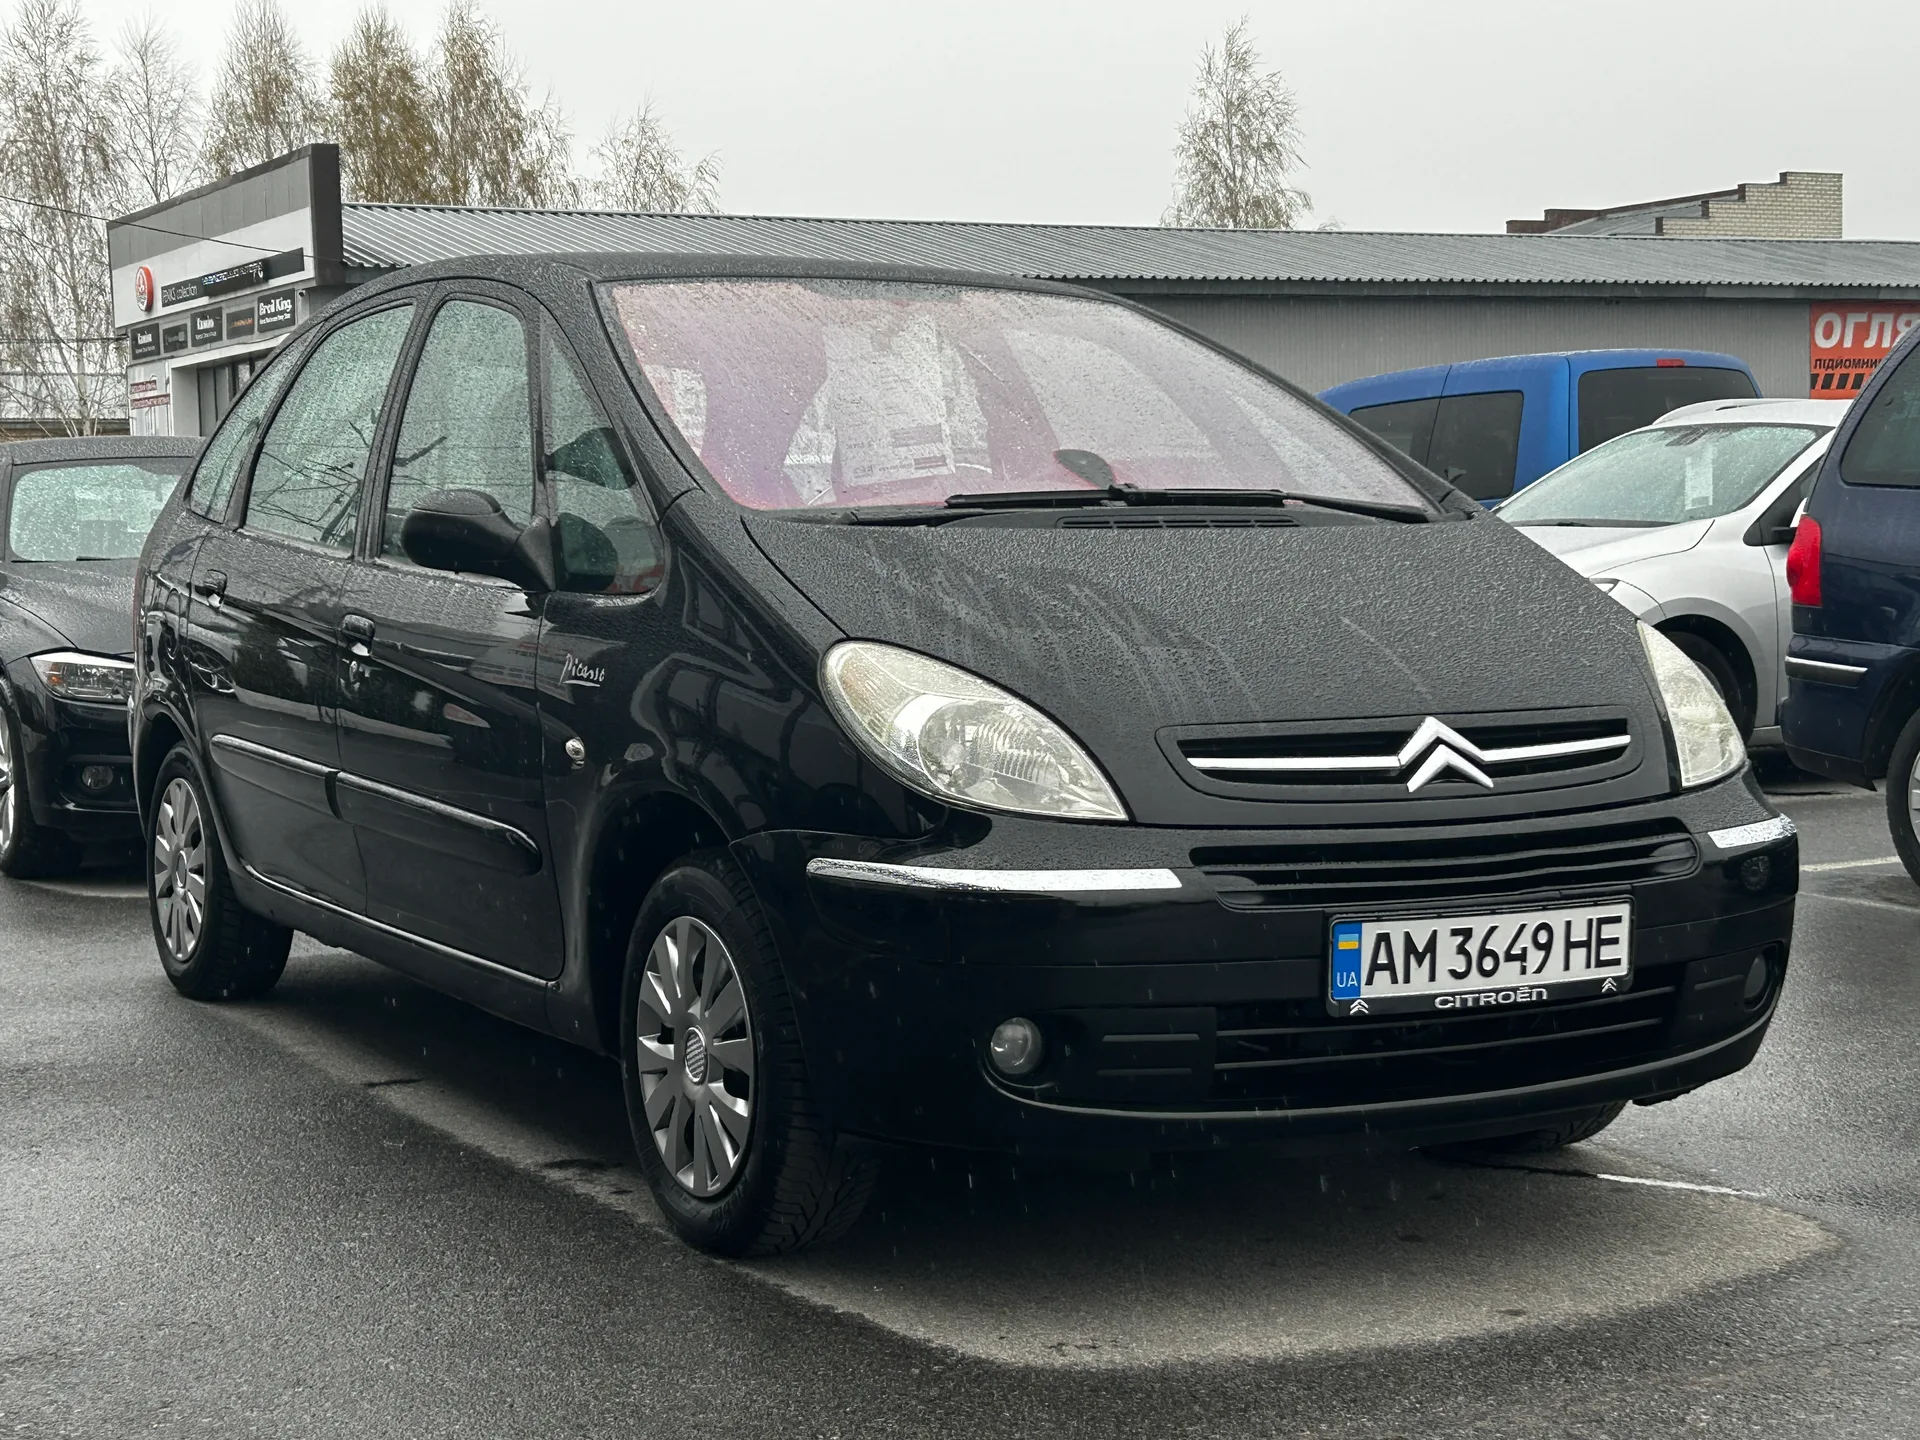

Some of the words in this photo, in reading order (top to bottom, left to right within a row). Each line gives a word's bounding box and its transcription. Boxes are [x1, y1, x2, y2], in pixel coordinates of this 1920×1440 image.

[1813, 357, 1882, 371] ПІДЙОМНИ
[558, 653, 605, 687] Picasso
[1336, 971, 1358, 988] UA
